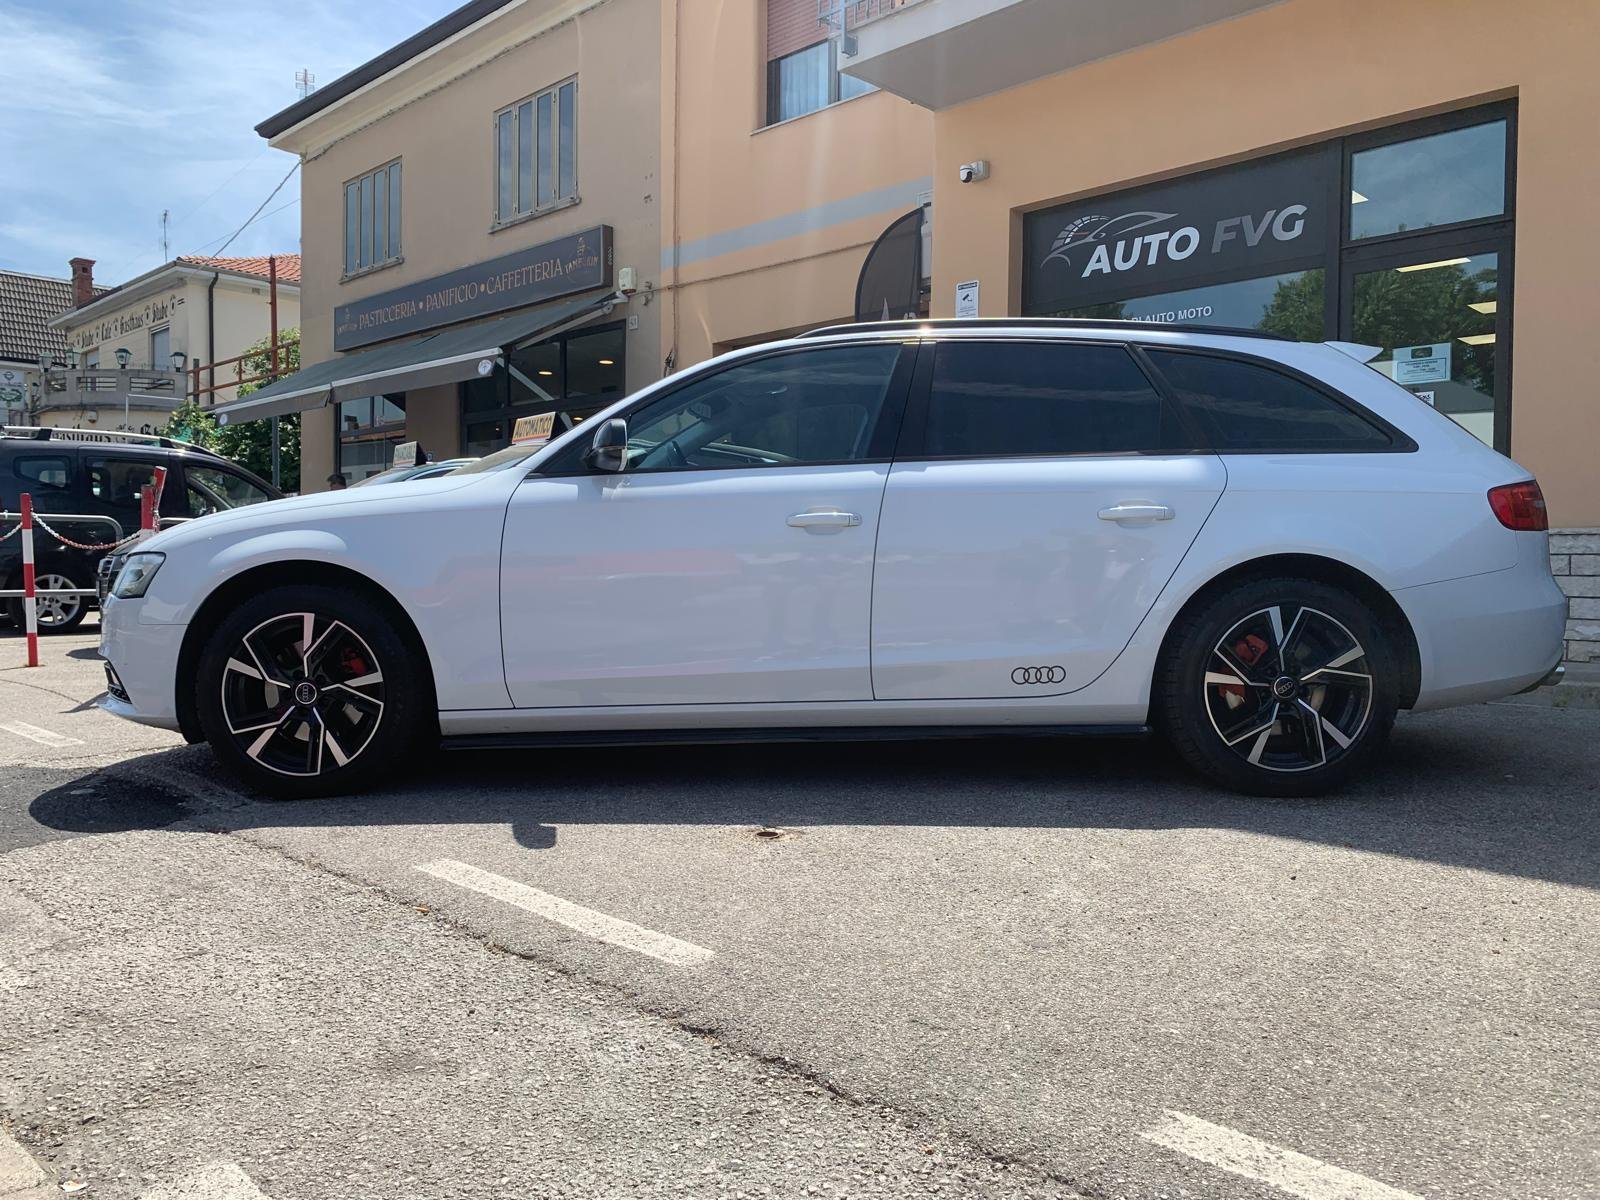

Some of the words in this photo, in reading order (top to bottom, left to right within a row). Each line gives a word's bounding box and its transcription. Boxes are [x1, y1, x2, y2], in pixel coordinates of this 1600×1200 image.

[1081, 226, 1200, 278] AUTO
[1211, 204, 1308, 254] FVG
[359, 301, 417, 329] PASTICCERIA
[426, 282, 478, 312] PANIFICIO
[486, 258, 563, 295] CAFFETTERIA
[1178, 305, 1212, 320] MOTO
